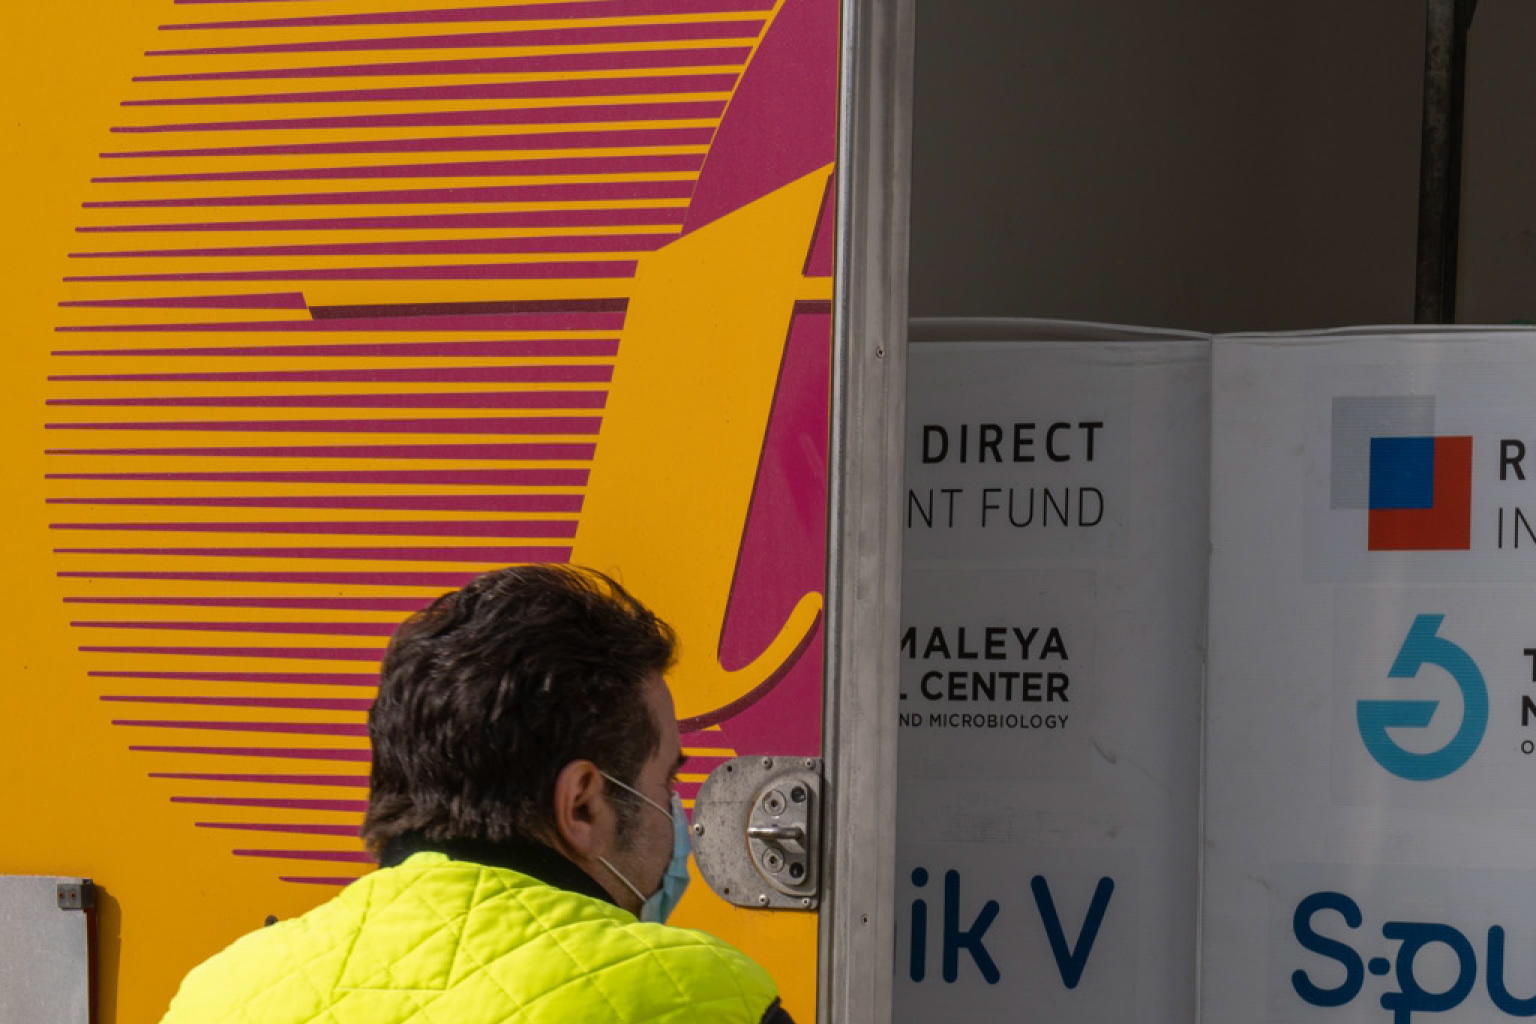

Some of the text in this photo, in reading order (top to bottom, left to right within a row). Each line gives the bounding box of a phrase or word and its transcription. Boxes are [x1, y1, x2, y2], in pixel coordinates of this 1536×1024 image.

[923, 422, 1103, 463] DIRECT
[982, 487, 1104, 527] FUND
[921, 671, 1069, 702] CENTER
[930, 714, 1068, 728] MICROBIOLOGY
[910, 866, 1114, 989] ik V
